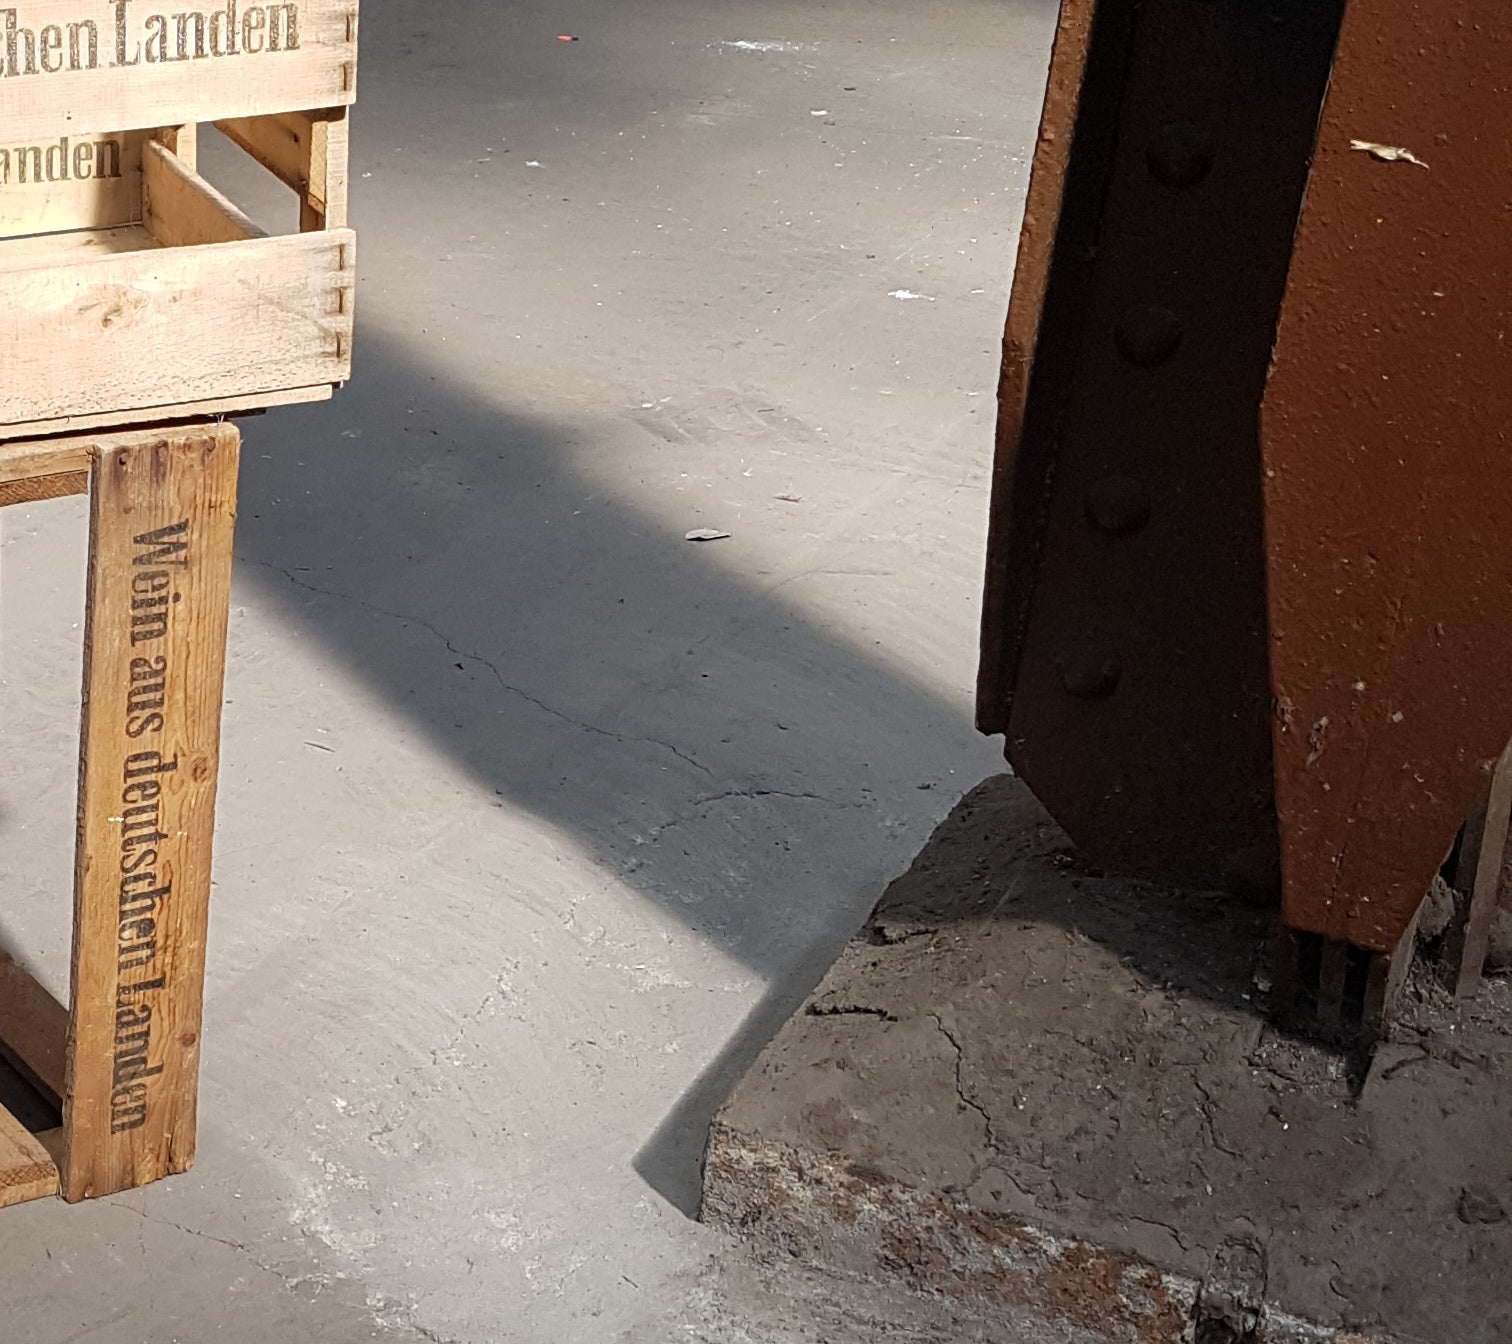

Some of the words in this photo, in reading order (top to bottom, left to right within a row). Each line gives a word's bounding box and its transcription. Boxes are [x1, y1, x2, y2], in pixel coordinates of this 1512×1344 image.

[130, 517, 190, 648] Wein
[124, 654, 169, 740] aus
[117, 749, 179, 972] deutschen
[109, 974, 168, 1135] Landen
